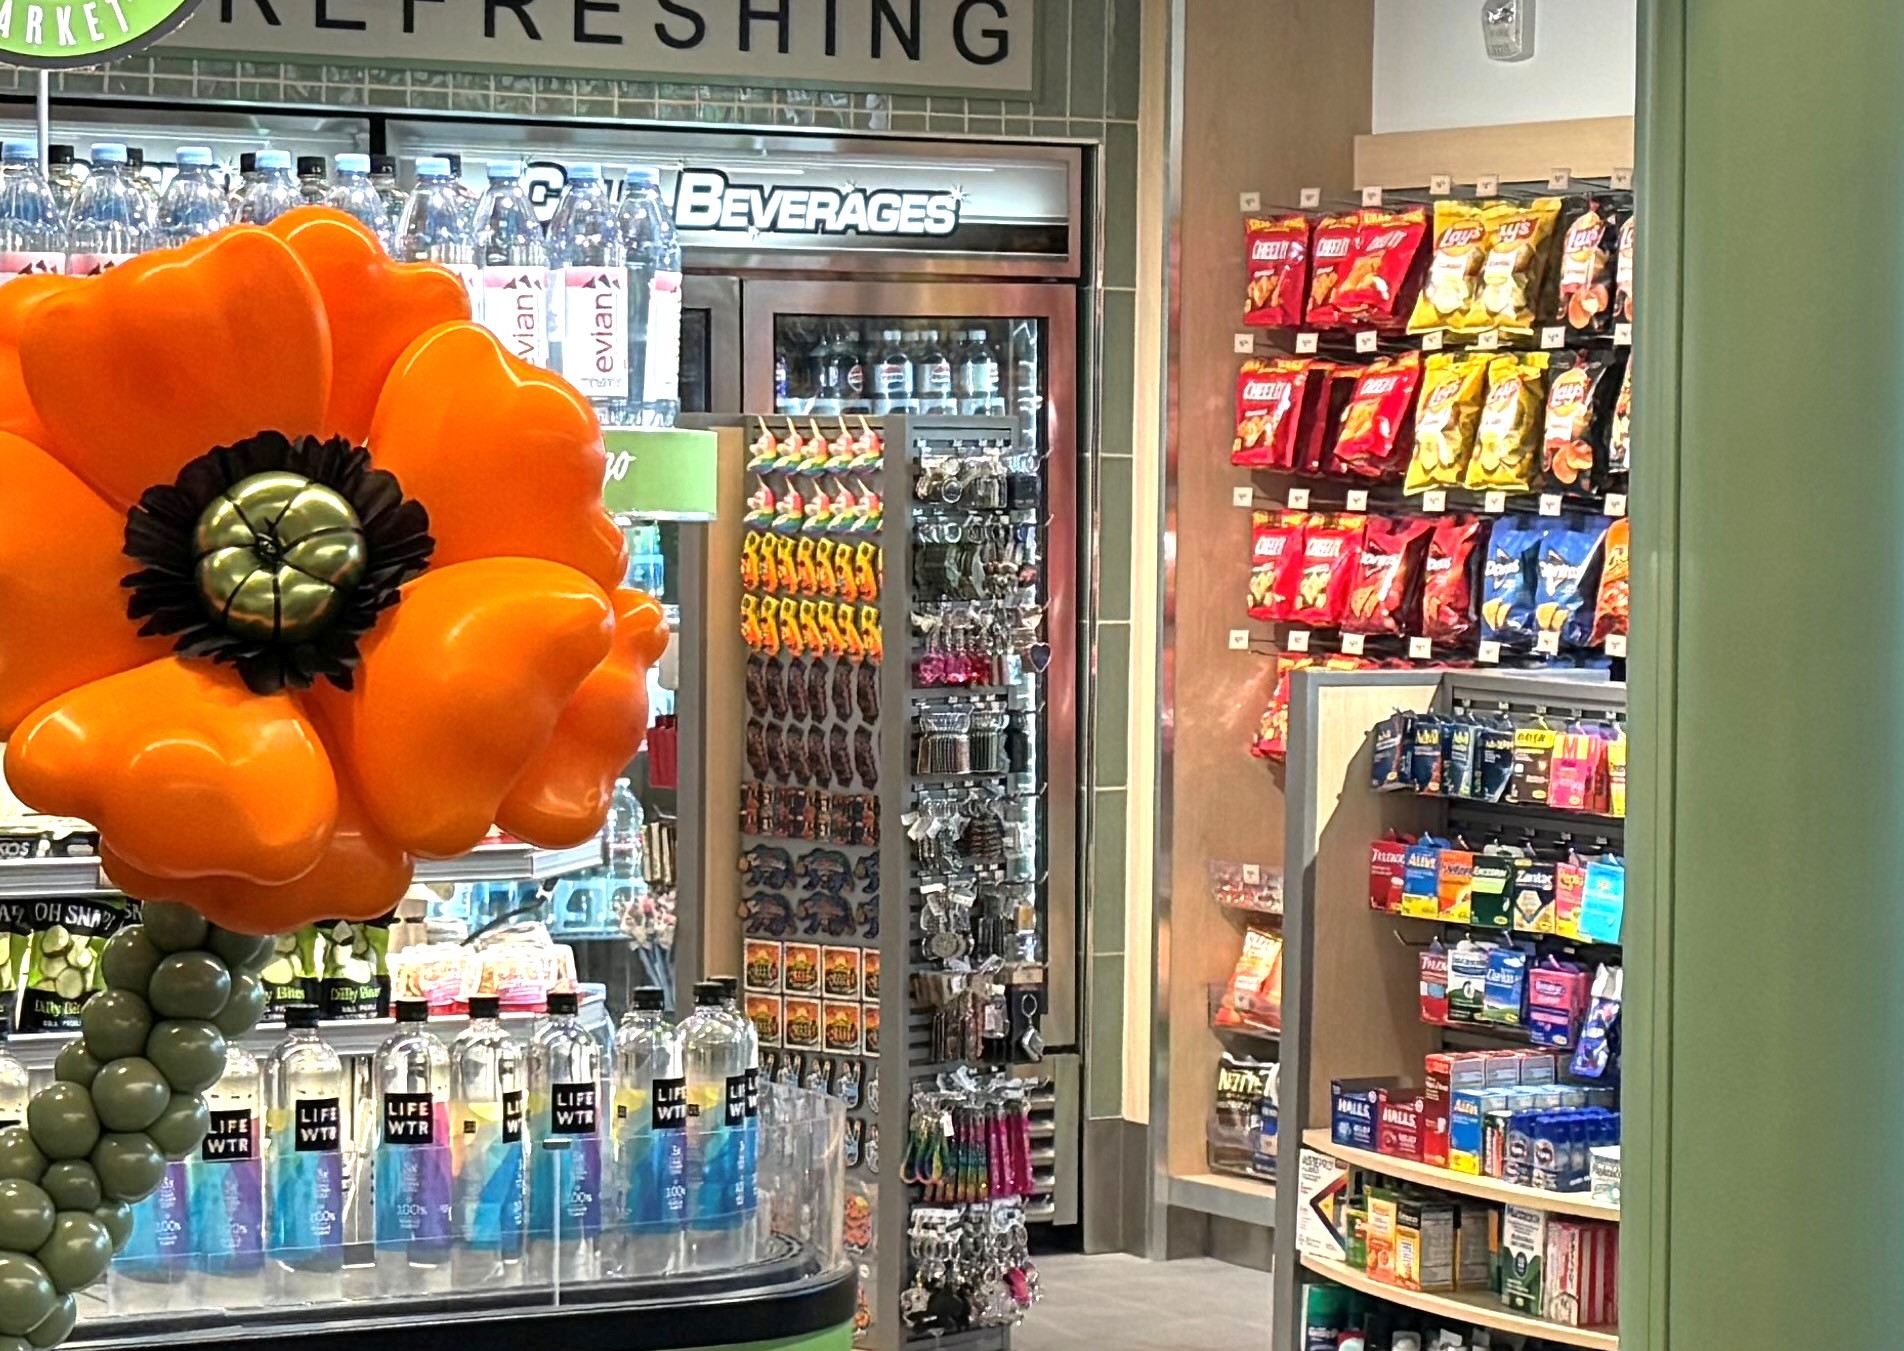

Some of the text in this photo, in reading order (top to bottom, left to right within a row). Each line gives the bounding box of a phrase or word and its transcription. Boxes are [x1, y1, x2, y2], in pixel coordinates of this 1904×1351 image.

[676, 169, 960, 236] BEVERAGES
[1440, 225, 1486, 247] Lay's
[591, 291, 614, 374] evian
[1515, 868, 1553, 885] Zantac
[34, 902, 62, 923] OH
[557, 1092, 594, 1107] LIFE
[1337, 1097, 1371, 1120] HALLS
[387, 1101, 430, 1118] LIFE
[557, 1110, 594, 1127] WTR
[1382, 1106, 1417, 1130] HALLS
[387, 1119, 430, 1136] WTR
[207, 1138, 249, 1154] WTR
